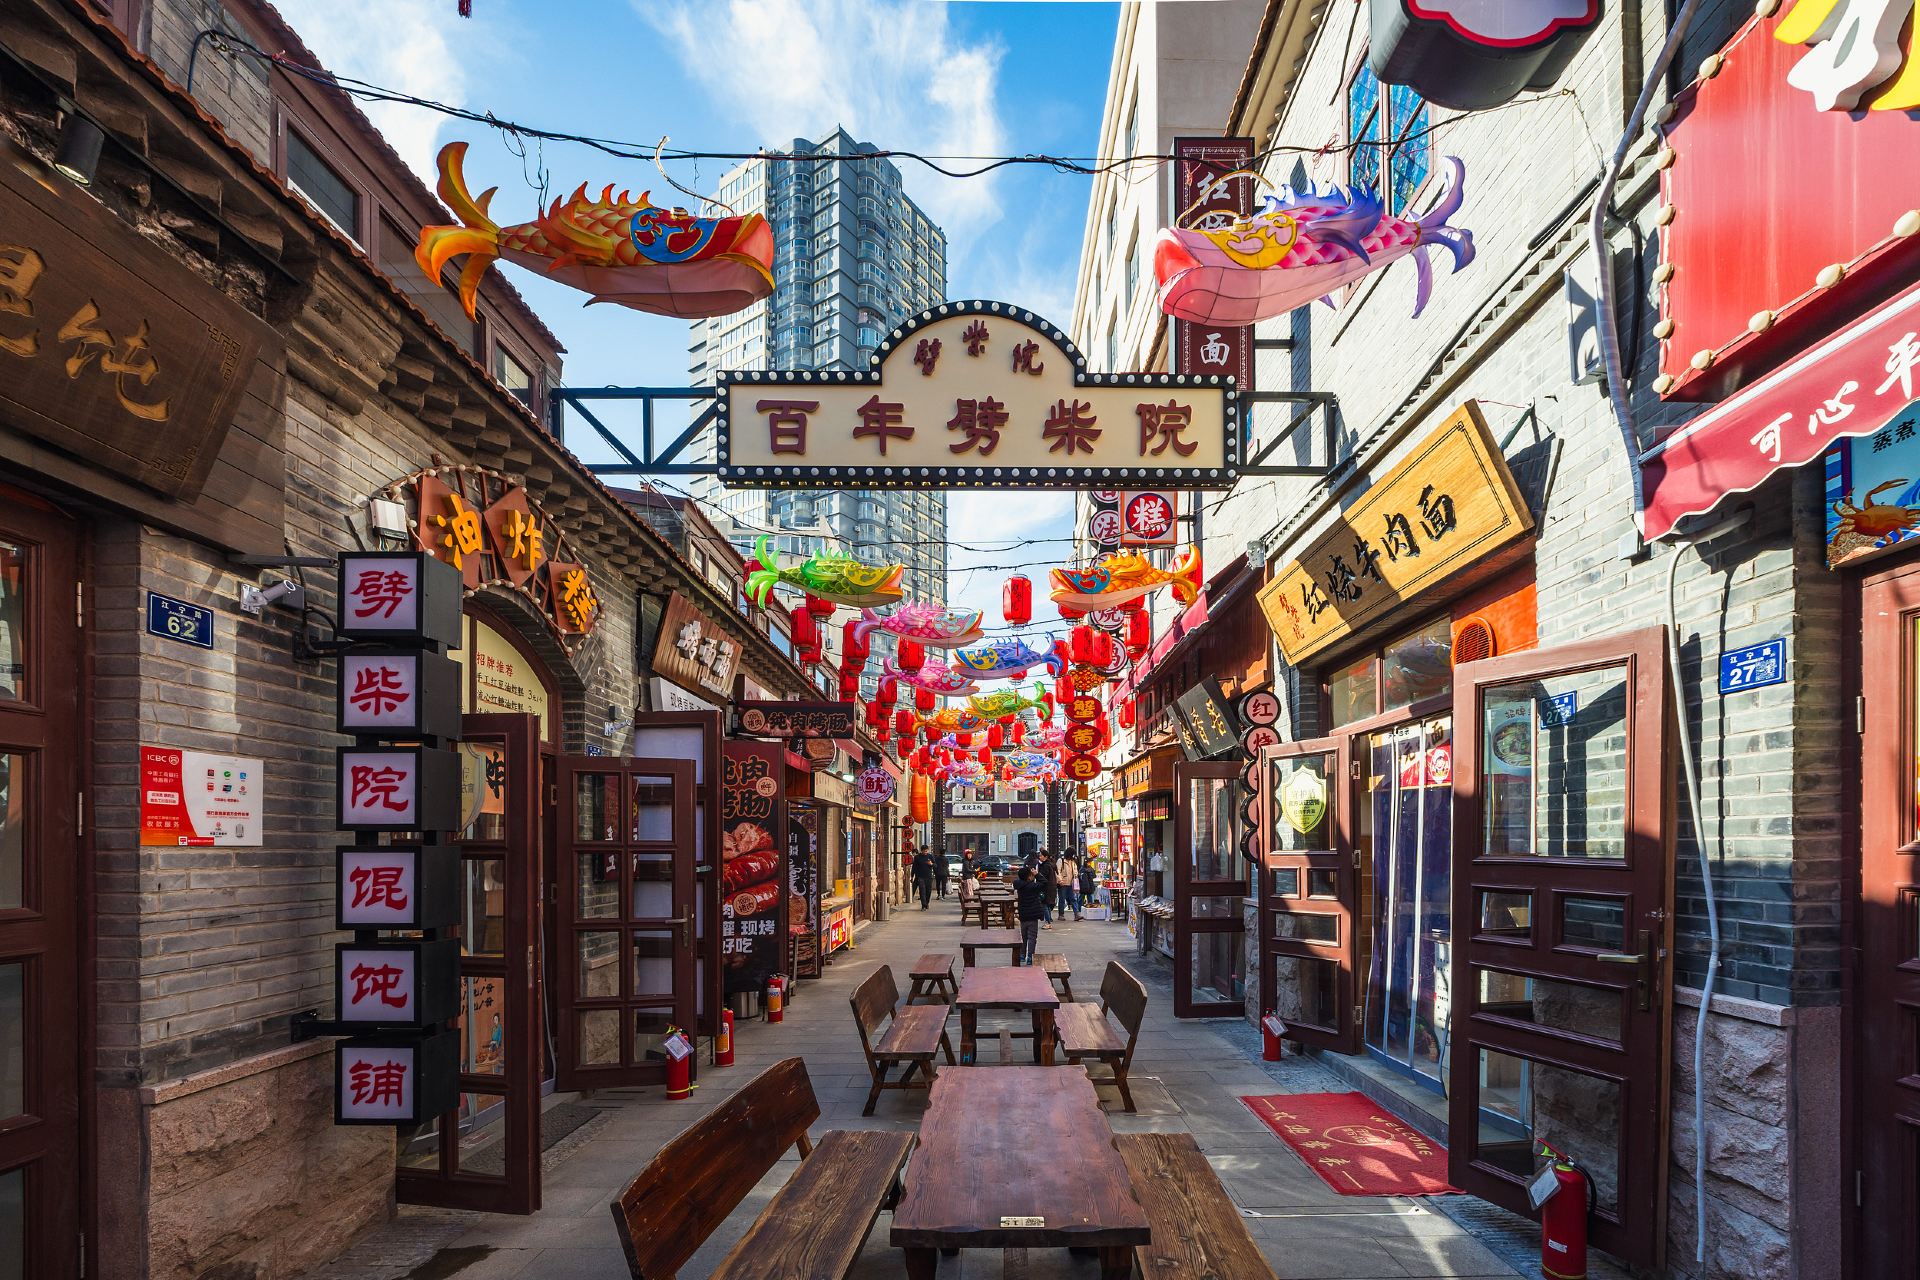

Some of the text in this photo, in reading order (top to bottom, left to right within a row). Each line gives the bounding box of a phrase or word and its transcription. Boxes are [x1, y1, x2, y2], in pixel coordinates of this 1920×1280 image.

[912, 318, 1046, 376] 劈柴院
[756, 394, 1200, 457] 百年劈柴院
[1132, 497, 1168, 535] 糕
[434, 493, 597, 632] 油炸糕
[1301, 483, 1457, 624] 红烧牛肉面
[167, 616, 197, 637] 62
[477, 651, 514, 678] 招牌推荐
[768, 711, 849, 733] 纯肉烤肠
[147, 754, 167, 763] ICBC
[865, 776, 887, 794] 鱿
[740, 919, 776, 936] 现烤
[1368, 1115, 1434, 1157] WELCOME
